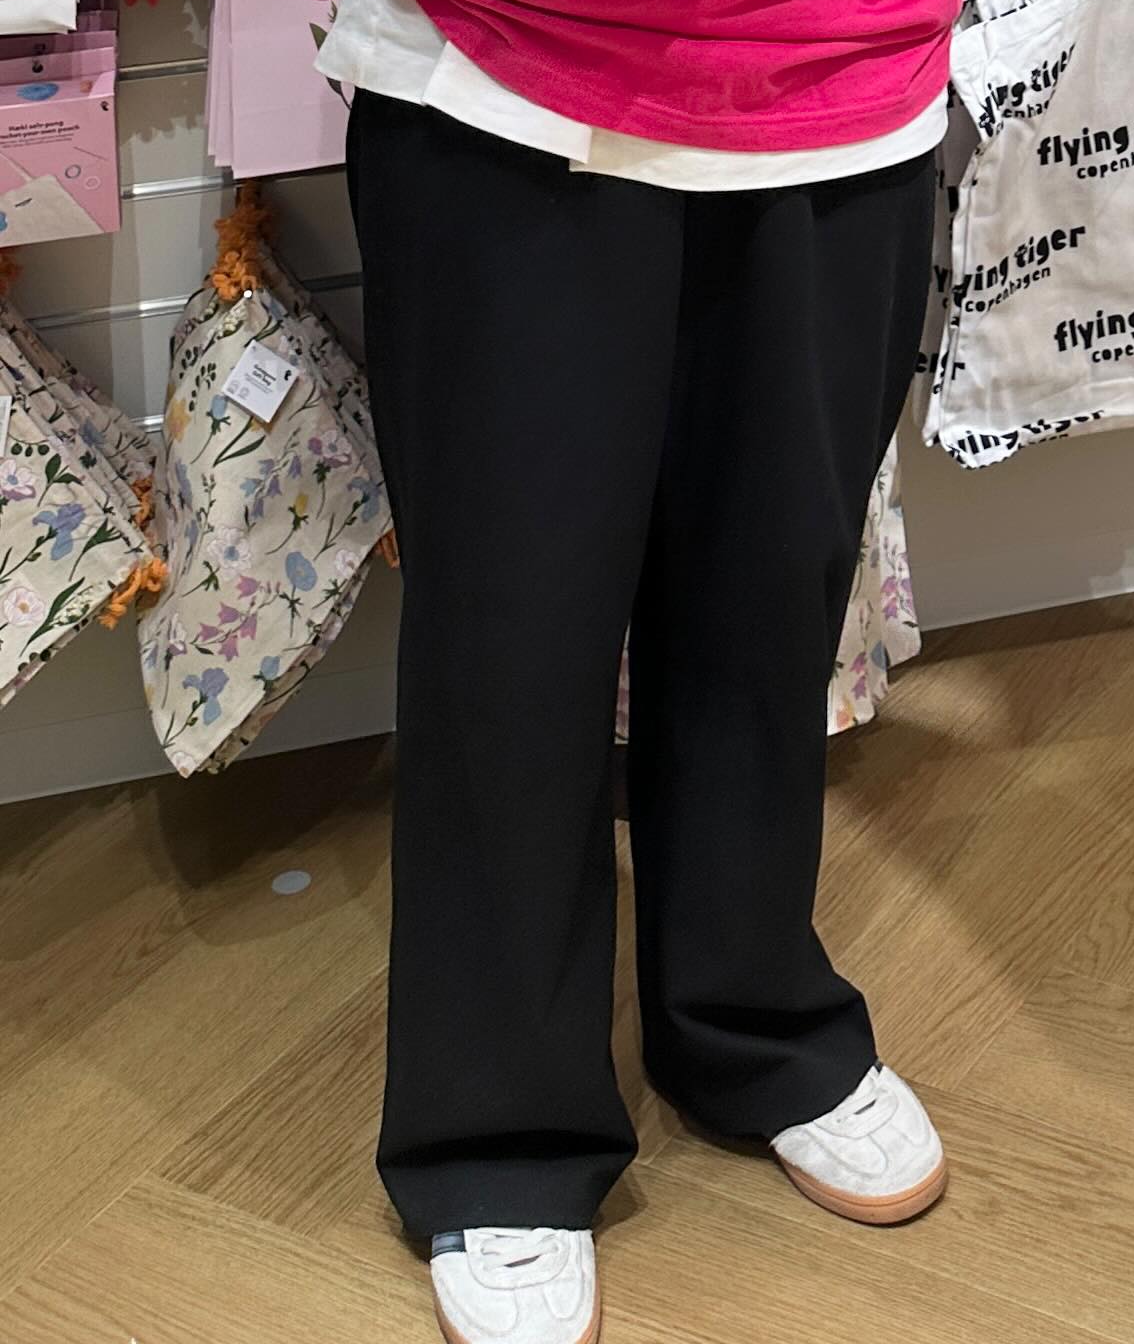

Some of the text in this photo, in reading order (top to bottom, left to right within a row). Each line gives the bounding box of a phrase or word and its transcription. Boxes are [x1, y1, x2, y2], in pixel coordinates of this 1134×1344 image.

[1037, 125, 1130, 167] flying
[1014, 226, 1086, 268] tiger
[965, 266, 1051, 313] copenhagen
